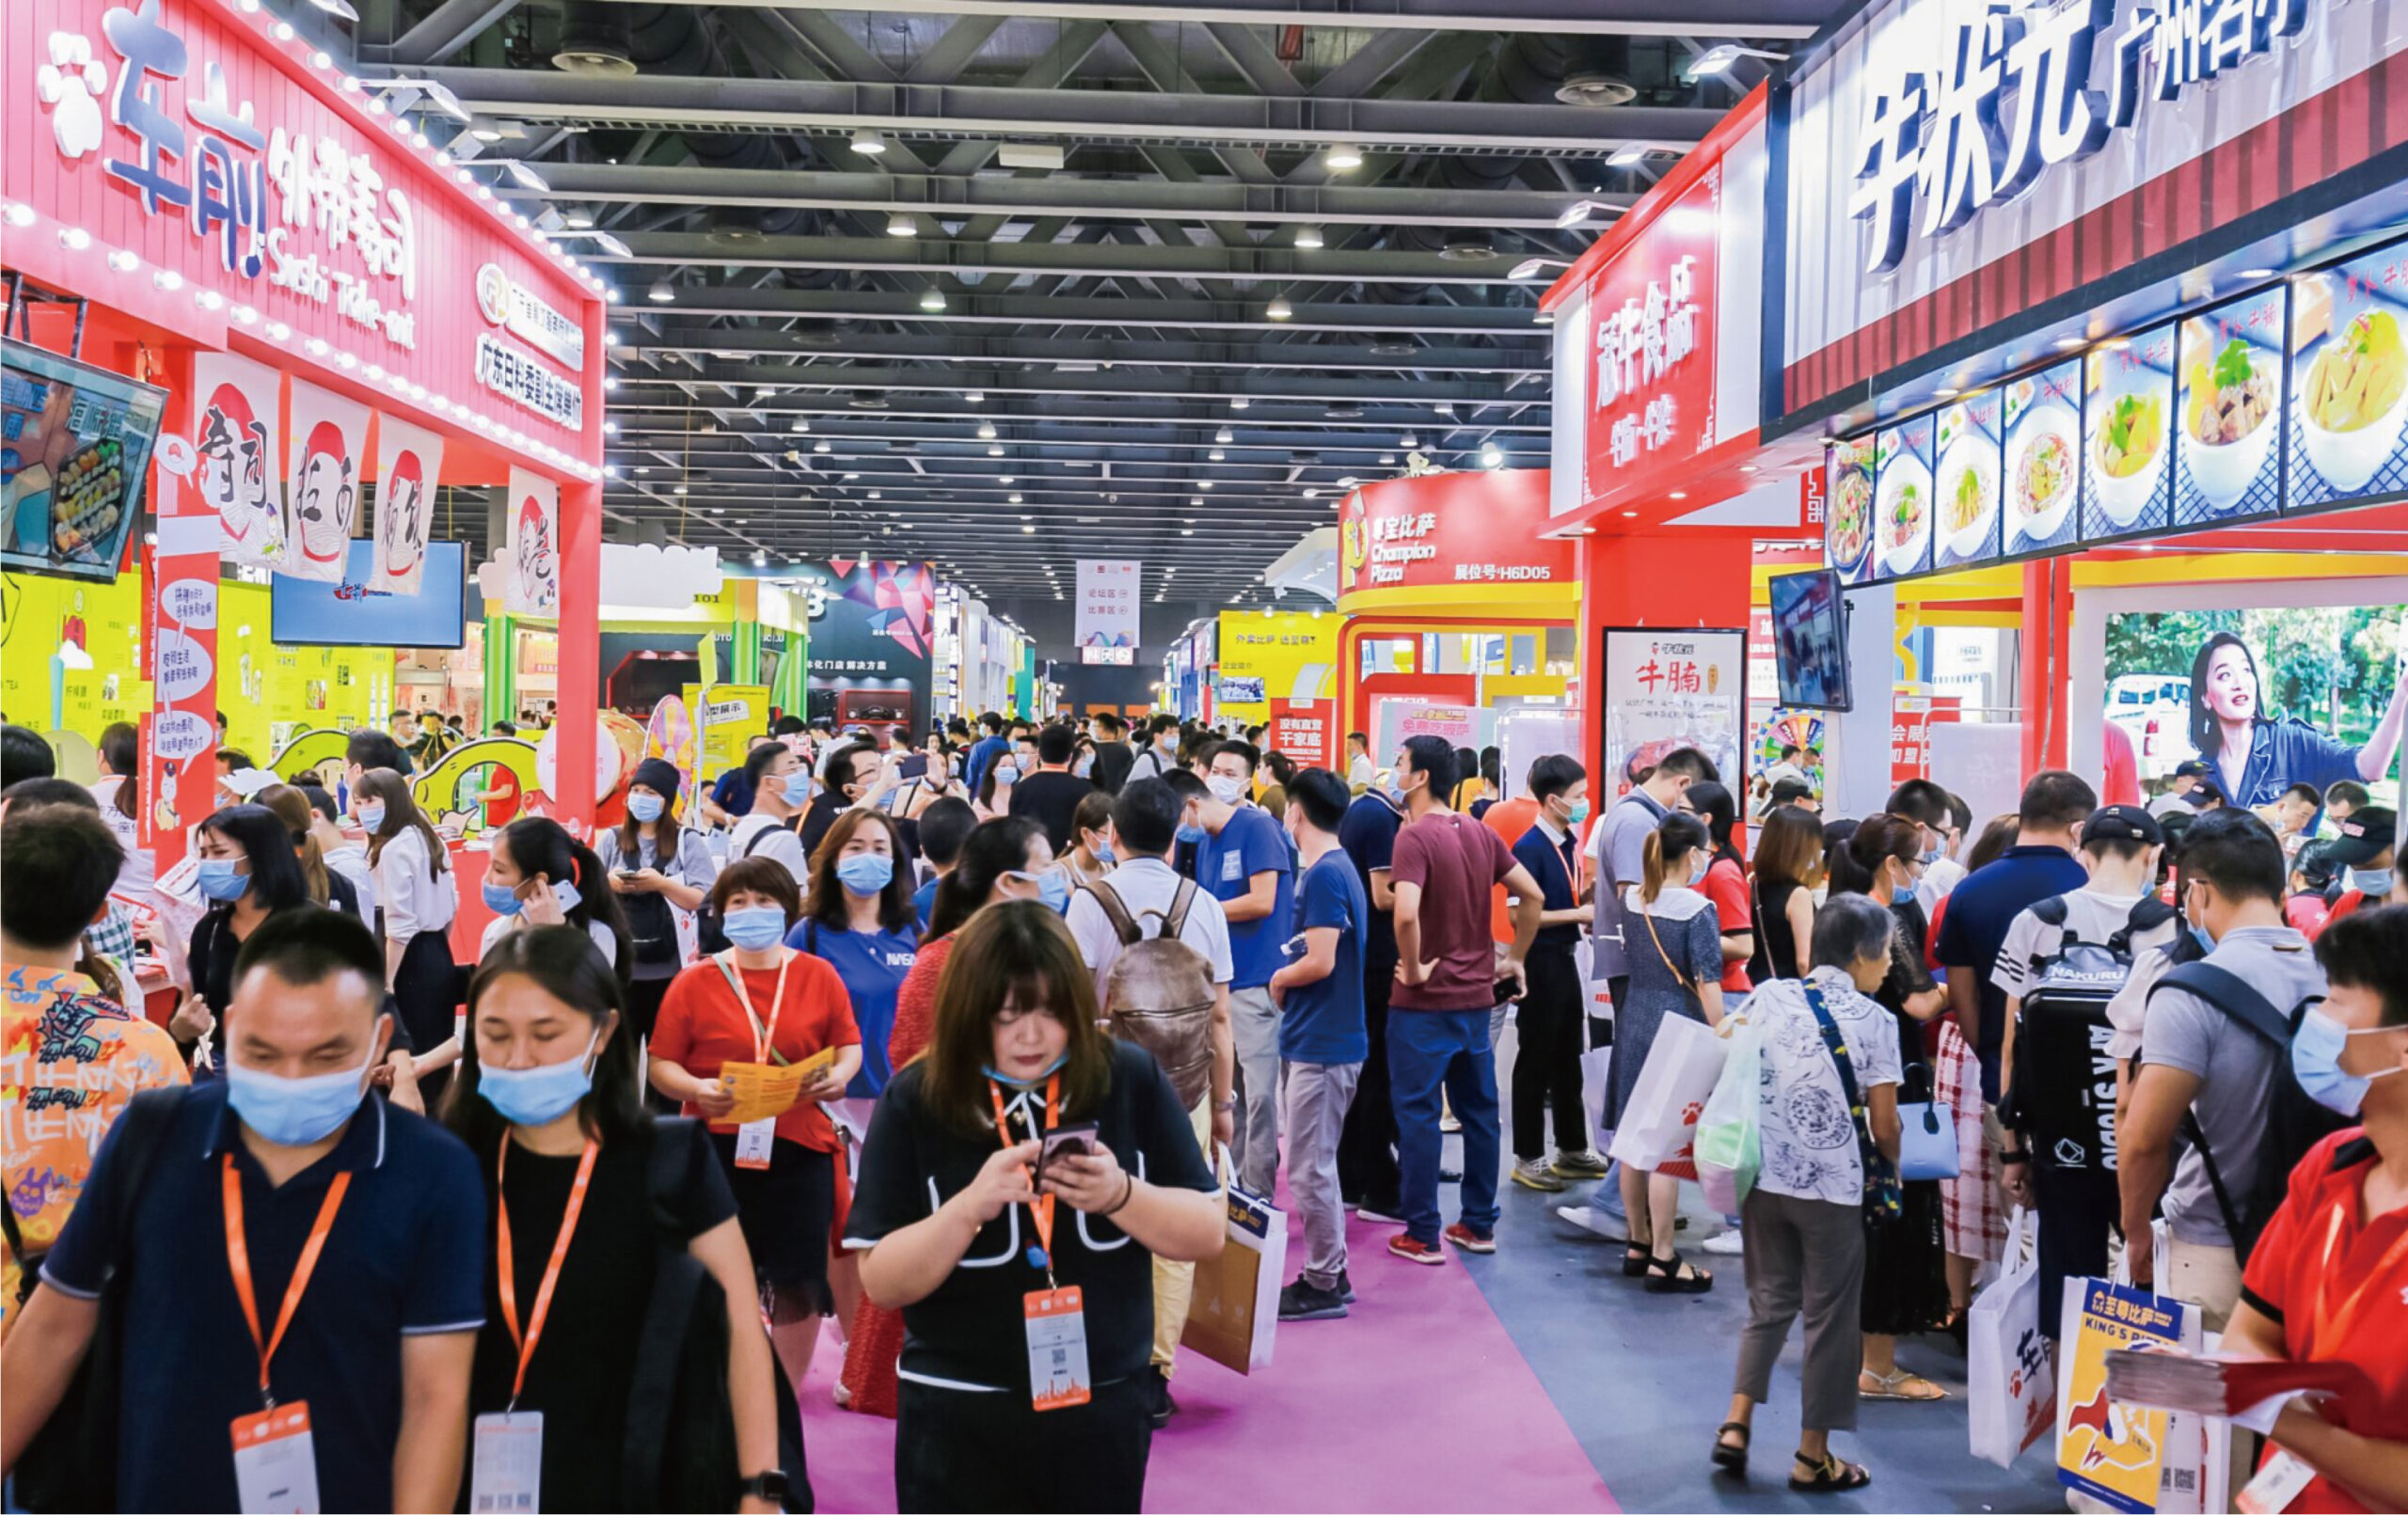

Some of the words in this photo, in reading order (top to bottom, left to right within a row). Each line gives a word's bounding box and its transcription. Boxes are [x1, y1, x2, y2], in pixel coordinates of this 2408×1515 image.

[1849, 0, 2103, 275] 牛状元
[268, 228, 327, 305] Sushi
[196, 403, 267, 509] 寿司
[1371, 543, 1436, 564] Champion
[1370, 565, 1404, 583] Pizza
[1635, 658, 1702, 695] 牛腩
[886, 952, 916, 966] NASA
[2049, 967, 2126, 982] NAKURU
[2085, 1317, 2129, 1340] KING'S
